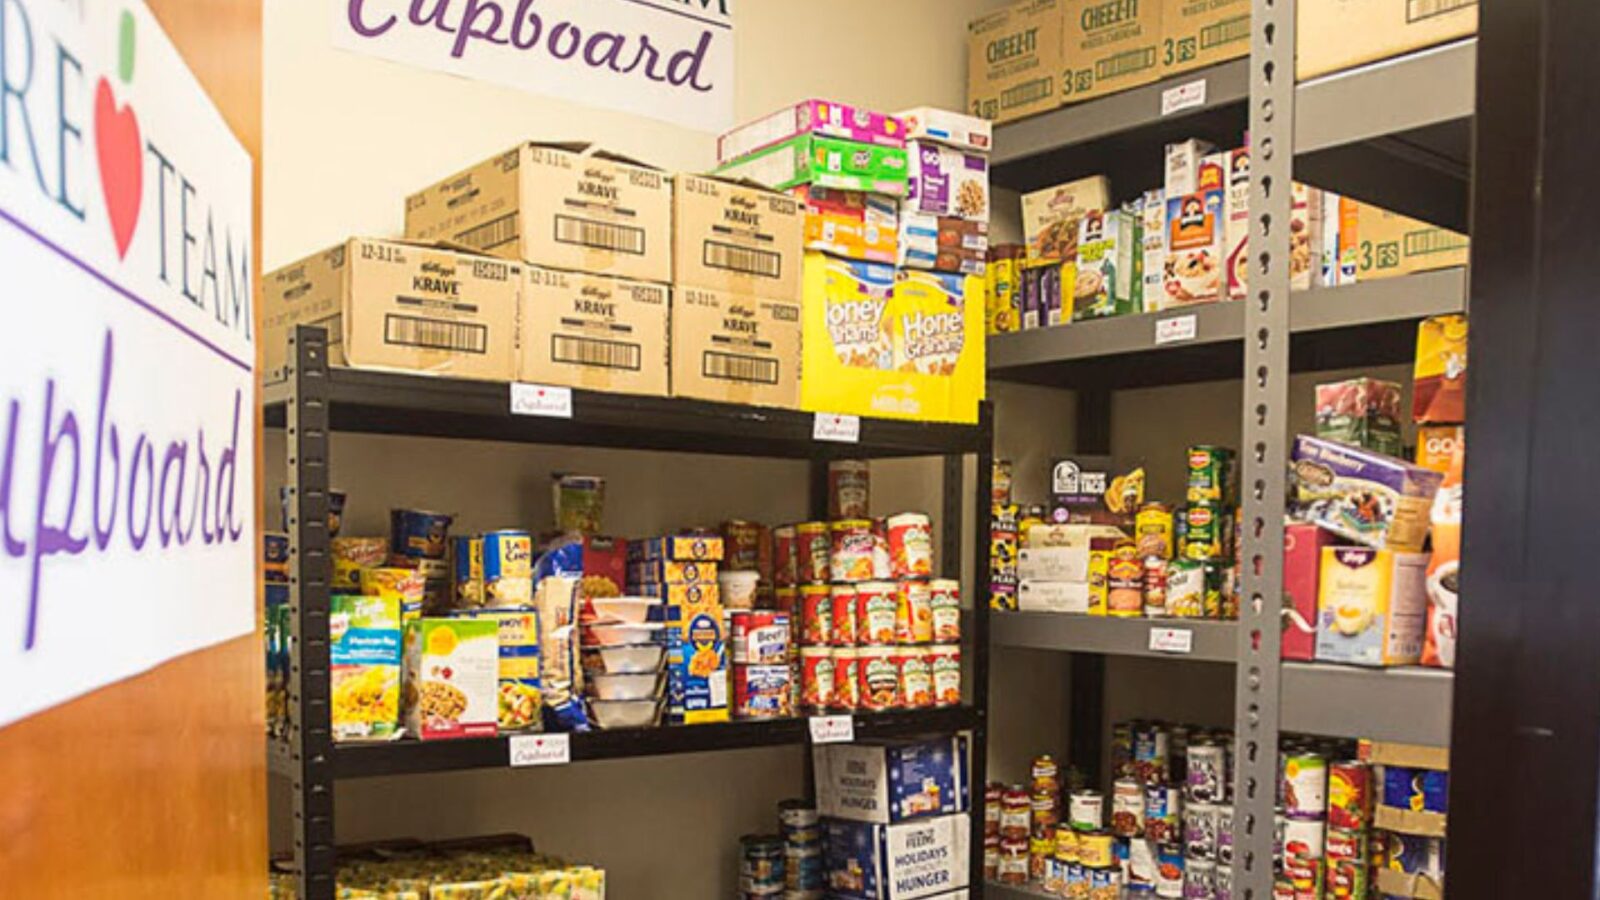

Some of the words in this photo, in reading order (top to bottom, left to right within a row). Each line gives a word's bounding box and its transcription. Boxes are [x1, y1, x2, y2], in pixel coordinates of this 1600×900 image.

[1163, 37, 1175, 66] 3
[1062, 69, 1074, 95] 3
[577, 180, 619, 200] KRAVE
[724, 207, 760, 226] KRAVE
[146, 140, 252, 342] TEAM
[1360, 240, 1373, 271] 3
[412, 276, 460, 295] KRAVE
[574, 299, 617, 318] KRAVE
[723, 317, 758, 334] KRAVE
[894, 846, 948, 868] HOLIDAYS
[896, 869, 950, 893] HUNGER
